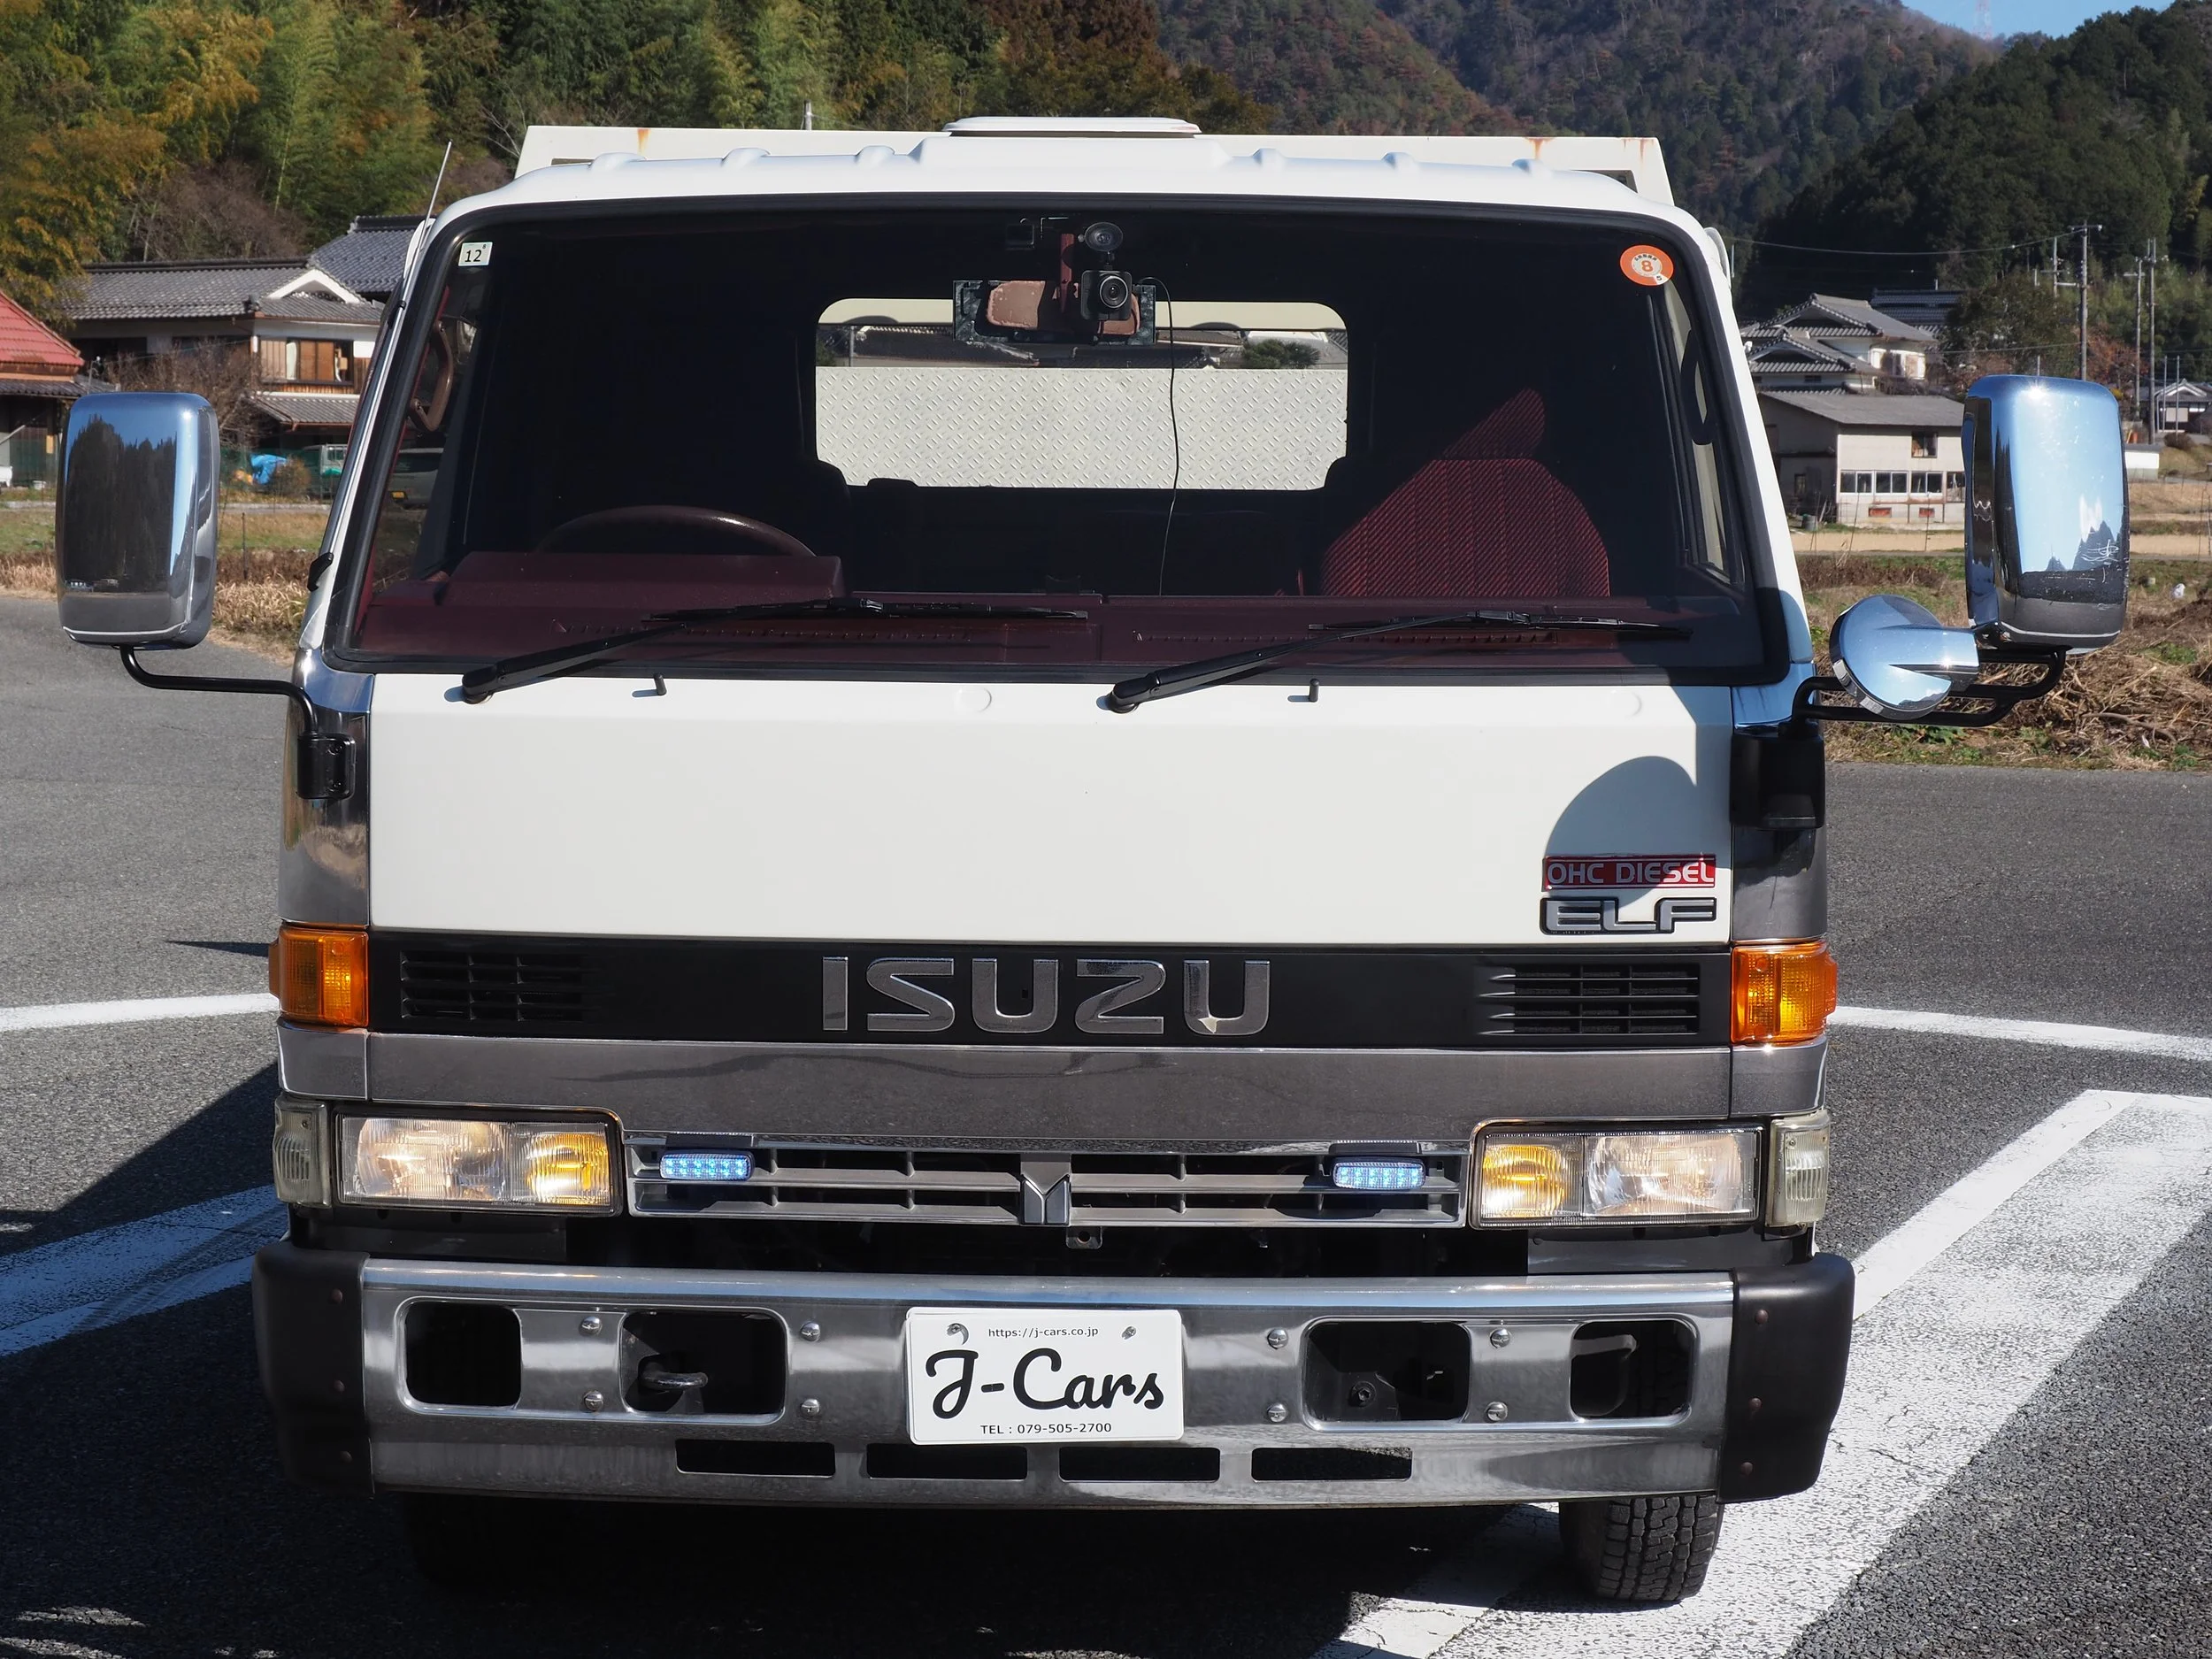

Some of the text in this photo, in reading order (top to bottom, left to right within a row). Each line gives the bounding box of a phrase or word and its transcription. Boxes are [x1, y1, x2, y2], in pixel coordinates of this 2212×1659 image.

[465, 250, 482, 263] 12
[1641, 260, 1654, 272] 8
[1548, 862, 1715, 884] OHC DIESEL
[1541, 897, 1717, 934] ELF
[822, 956, 1271, 1035] ISUZU
[988, 1327, 1099, 1339] https://j-cars.co.jp
[926, 1348, 1164, 1419] J-Cars
[1017, 1423, 1112, 1434] 079-505-2700
